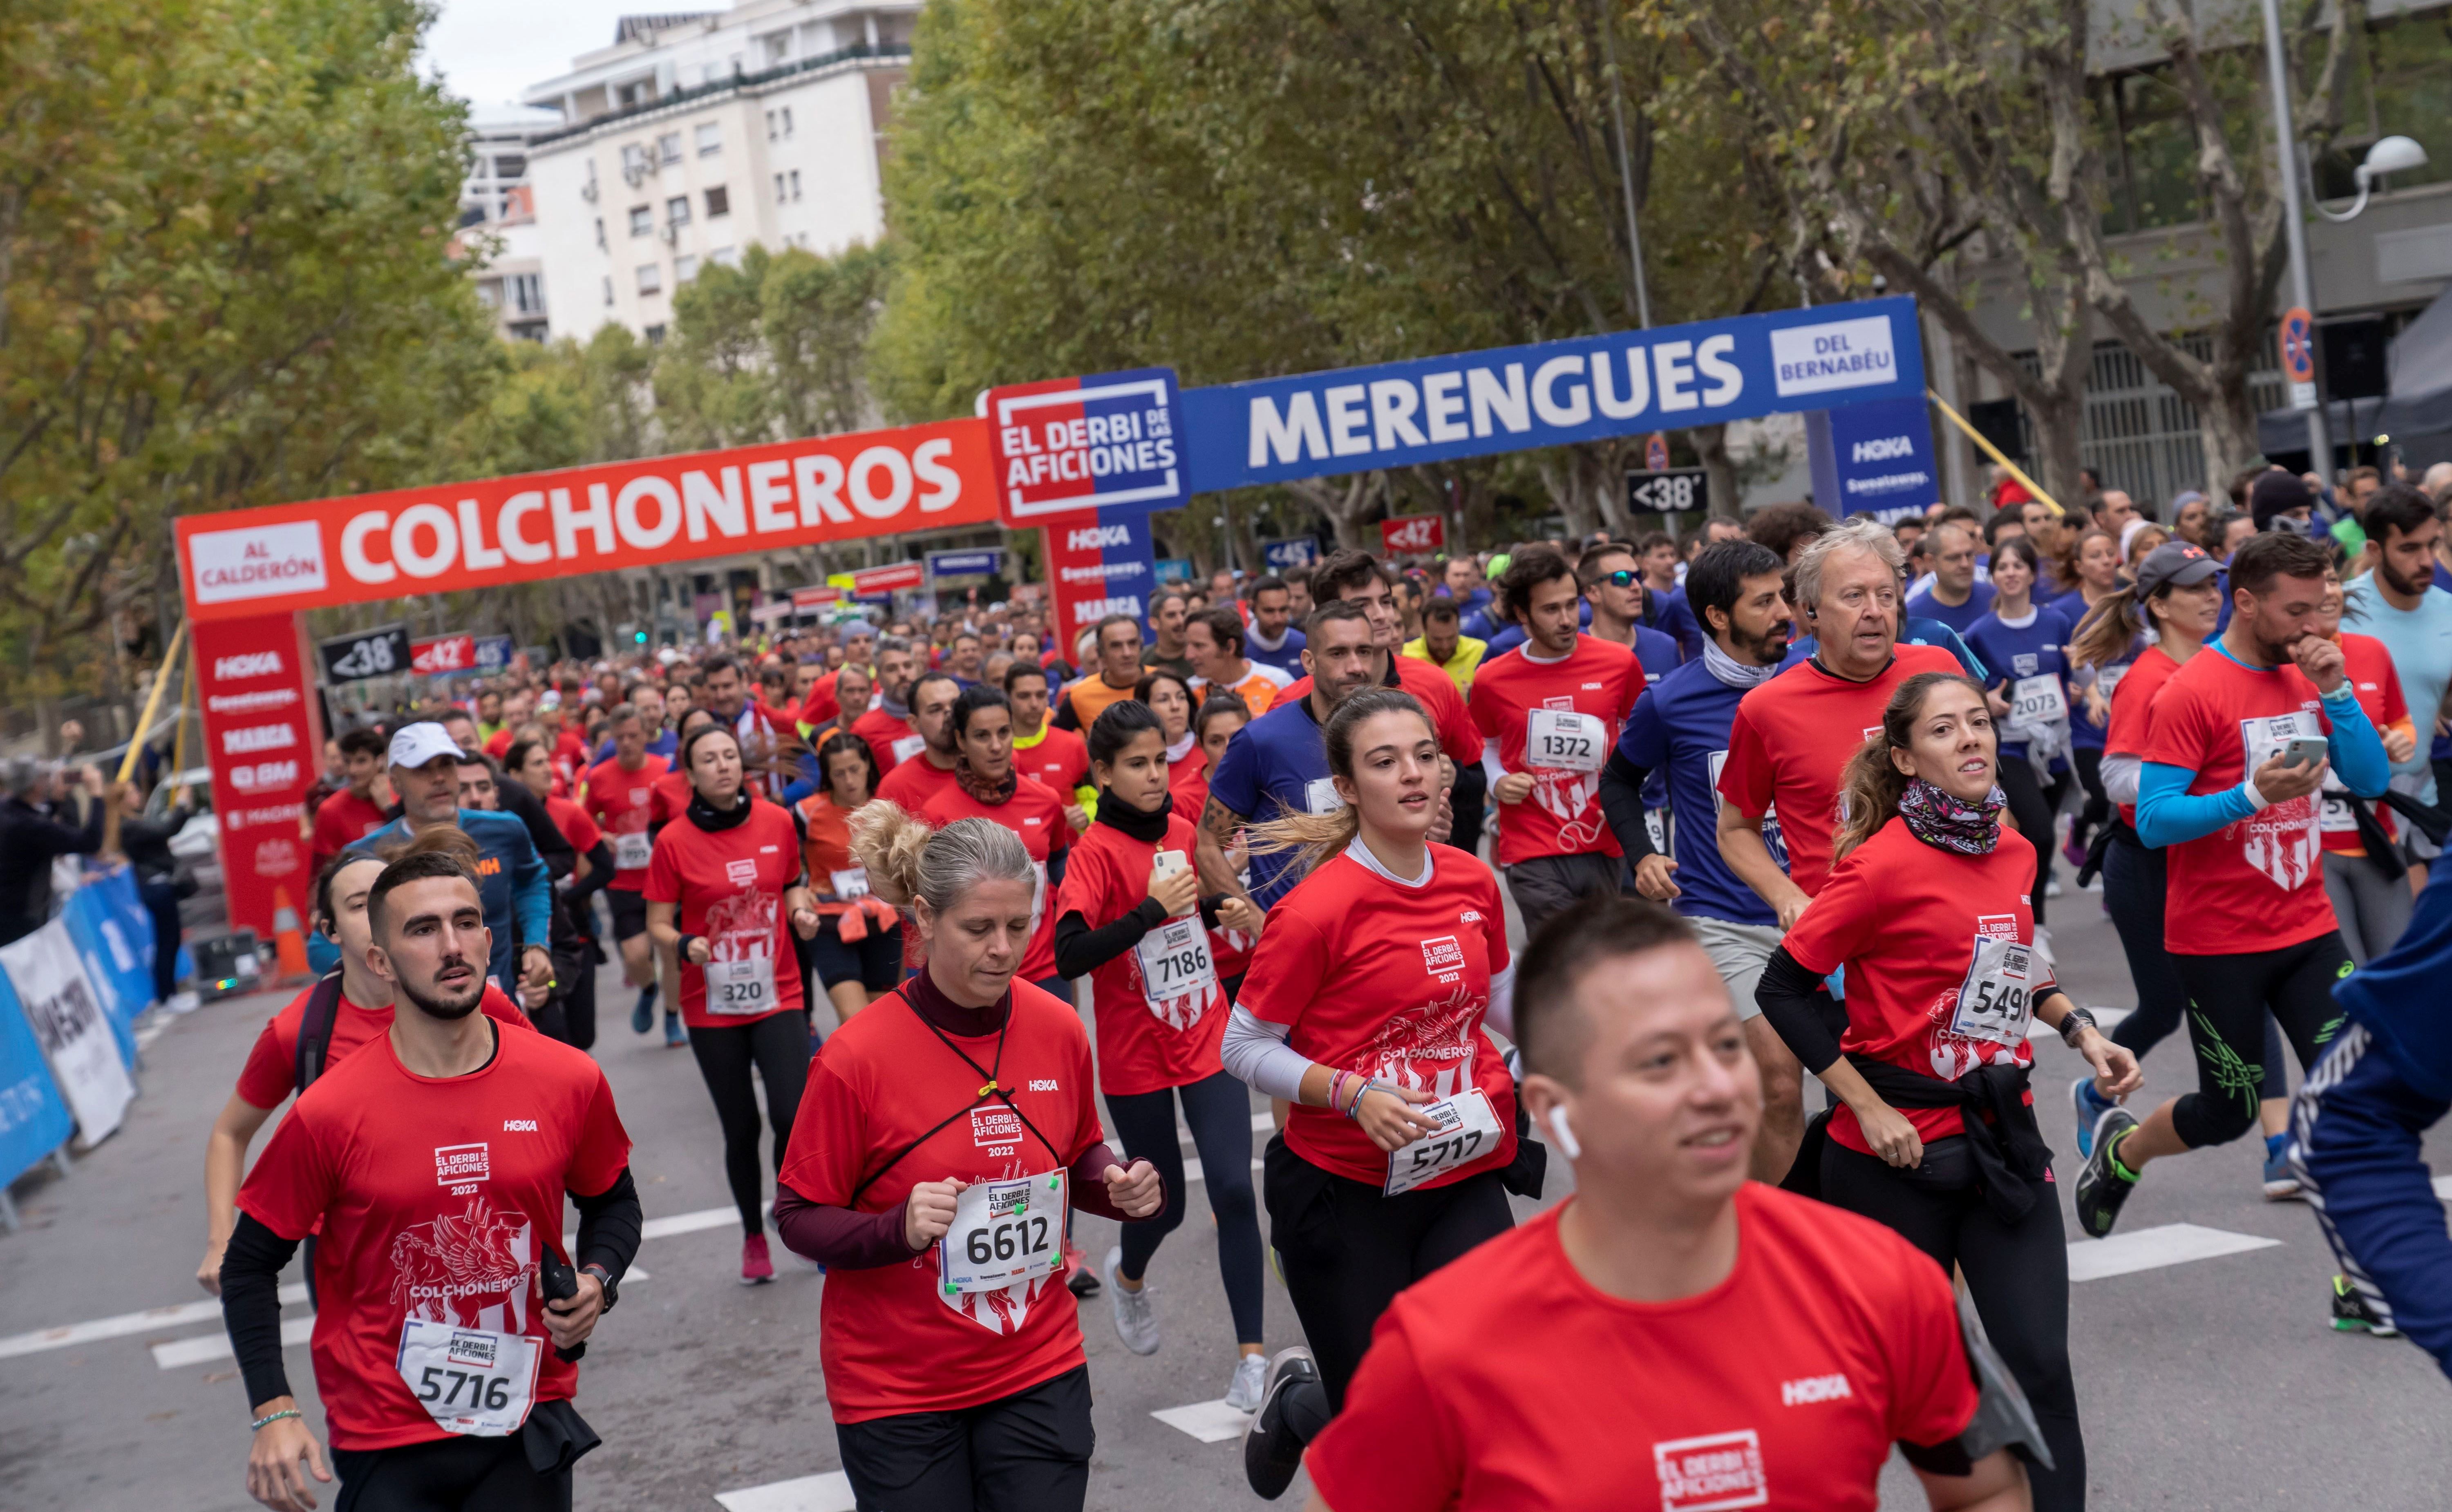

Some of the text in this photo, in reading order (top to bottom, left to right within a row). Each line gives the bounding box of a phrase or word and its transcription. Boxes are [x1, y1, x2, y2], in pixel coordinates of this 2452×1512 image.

[1814, 333, 1852, 354] DEL
[1781, 349, 1890, 382] BERNABÉU
[1248, 334, 1743, 468] MERENGUES
[1145, 408, 1168, 425] DE
[1001, 411, 1141, 458] EL DERBI
[1148, 423, 1172, 438] LAS
[1852, 436, 1913, 463] HOKA
[1007, 438, 1177, 488] AFICIONES
[340, 438, 962, 584] COLCHONEROS
[1067, 524, 1131, 551] HOKA
[244, 541, 269, 558] AL
[201, 559, 317, 589] CALDERÓN
[1074, 595, 1143, 624] MARCA
[215, 651, 283, 680] HOKA
[2014, 693, 2056, 715] 2073
[1544, 736, 1591, 757] 1372
[1460, 911, 1482, 924] HOKA
[1980, 922, 2011, 933] EL DERBI
[1423, 943, 1454, 957] EL DERBI
[1425, 951, 1463, 966] AFICIONES
[1157, 946, 1207, 983] 7186
[1439, 972, 1460, 984] 2022
[723, 982, 761, 1002] 320
[1380, 1045, 1474, 1061] COLCHONEROS
[1029, 1079, 1059, 1091] HOKA
[503, 1120, 537, 1132] HOKA
[972, 1114, 1012, 1127] EL DERBI
[974, 1123, 1022, 1137] AFICIONES
[436, 1153, 479, 1167] EL DERBI
[988, 1146, 1015, 1157] 2022
[1410, 1130, 1482, 1173] 5717
[437, 1162, 490, 1176] AFICIONES
[451, 1183, 478, 1196] 2022
[1001, 1190, 1024, 1201] DERBI
[989, 1197, 1030, 1211] AFICIONES
[967, 1216, 1049, 1265] 6612
[409, 1272, 528, 1298] COLCHONEROS
[449, 1347, 495, 1361] AFICIONES
[463, 1340, 488, 1351] DERBI
[417, 1366, 510, 1411] 5716
[1782, 1373, 1852, 1406] HOKA
